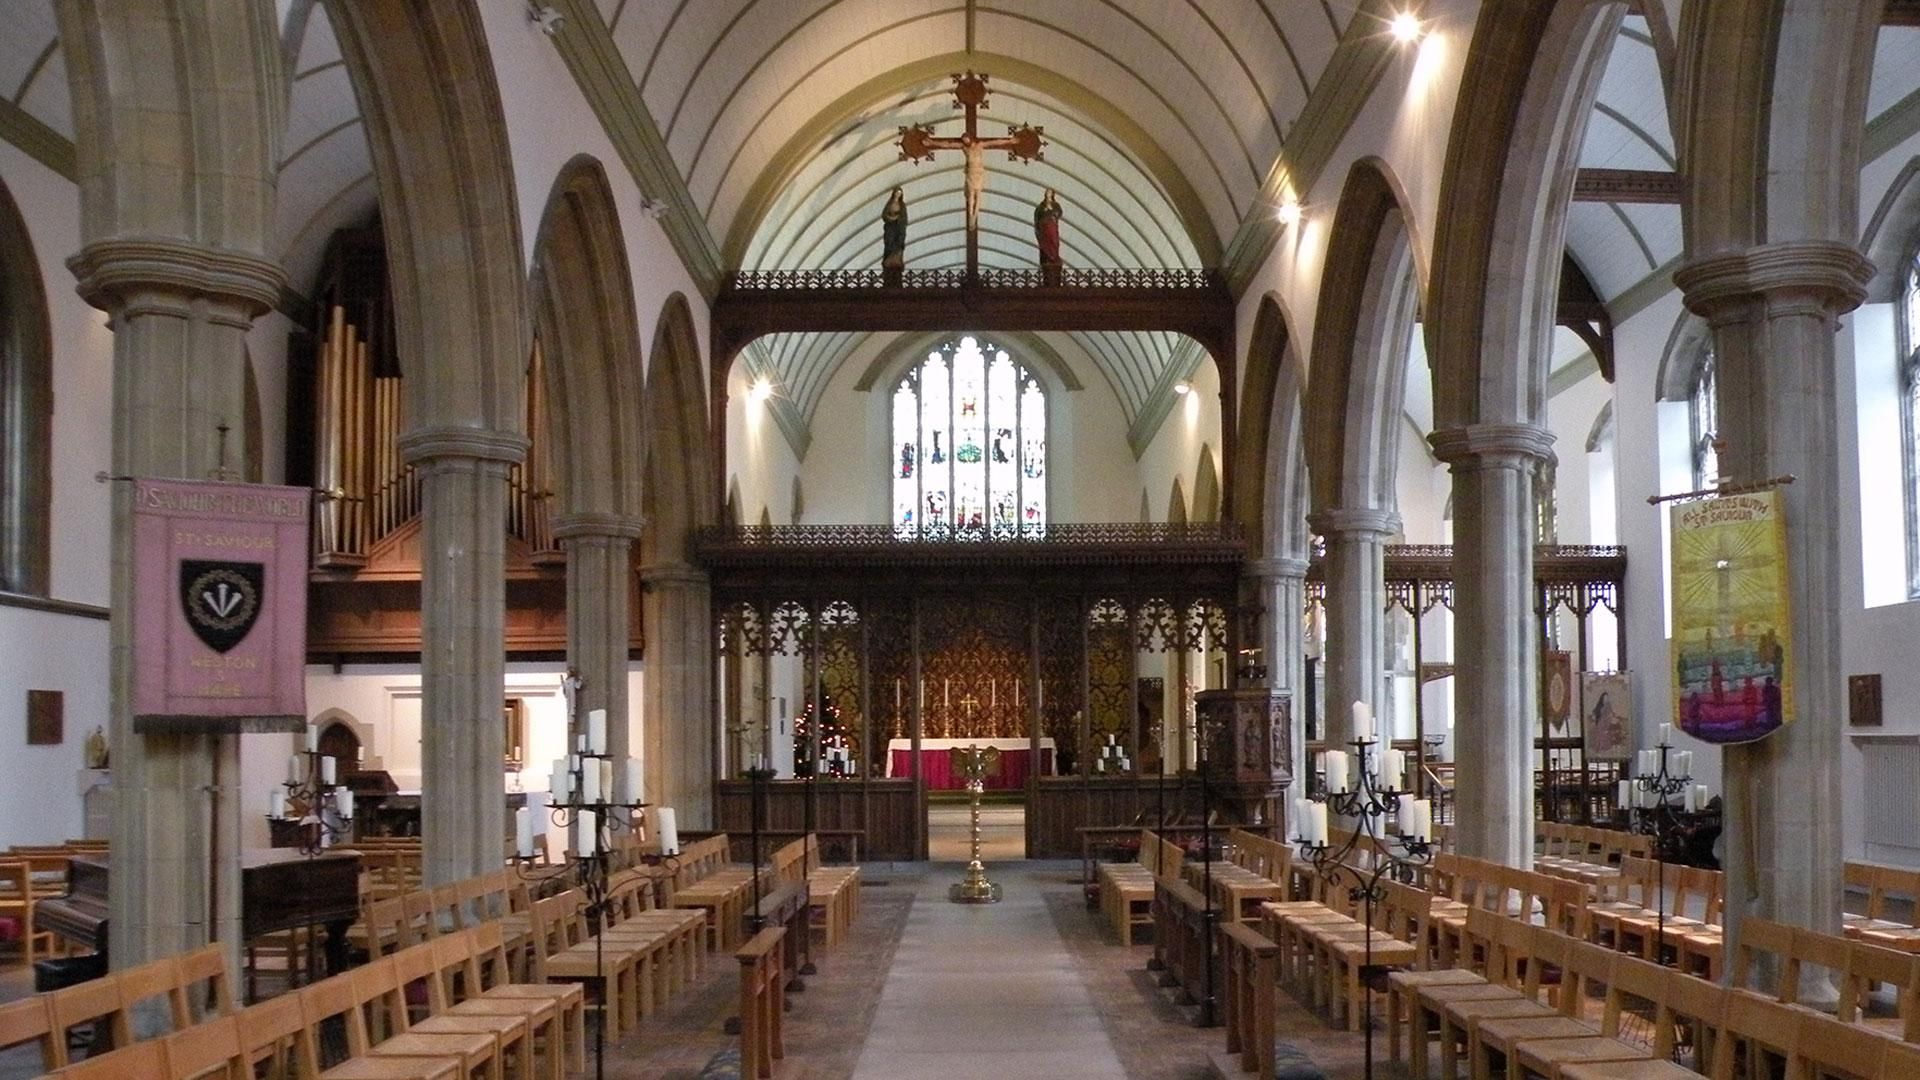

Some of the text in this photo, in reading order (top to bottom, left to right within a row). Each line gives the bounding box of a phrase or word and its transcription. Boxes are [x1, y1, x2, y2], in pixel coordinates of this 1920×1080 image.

[1683, 508, 1699, 526] ALL
[1739, 497, 1768, 514] WITH
[204, 534, 274, 549] SAVIOUR
[191, 656, 256, 669] WESTON
